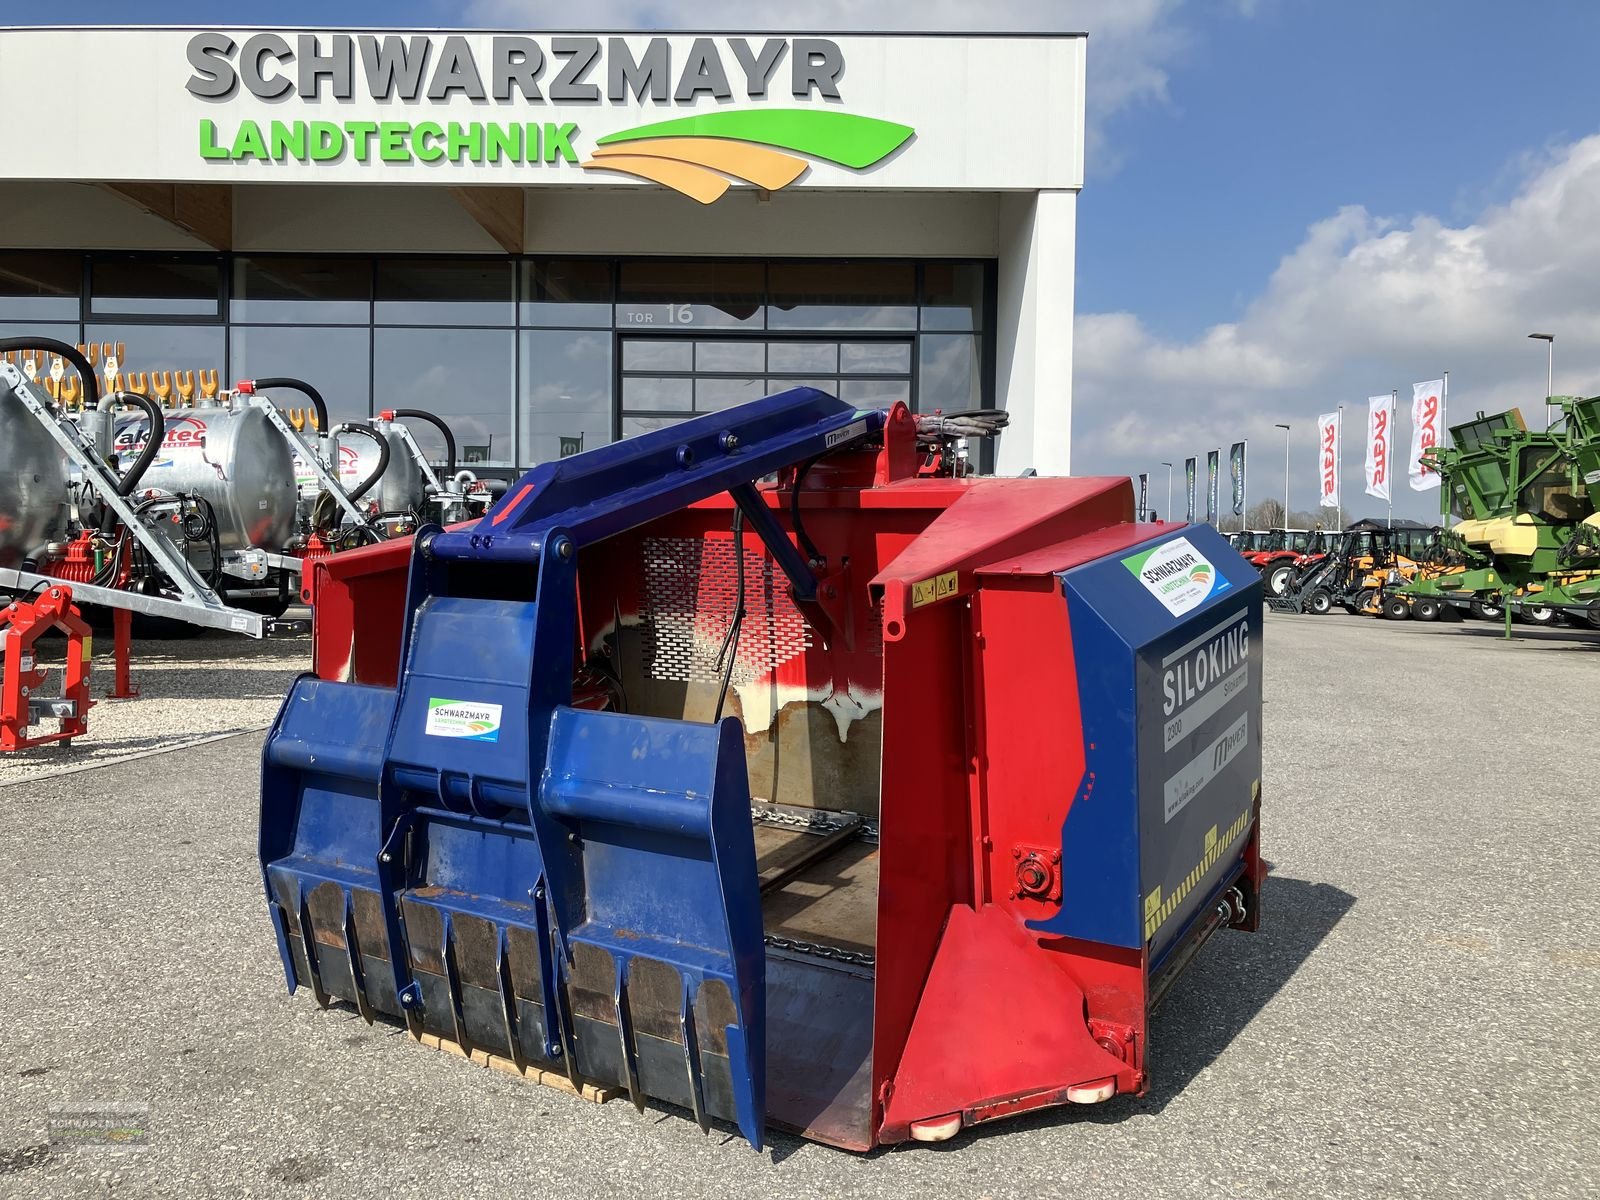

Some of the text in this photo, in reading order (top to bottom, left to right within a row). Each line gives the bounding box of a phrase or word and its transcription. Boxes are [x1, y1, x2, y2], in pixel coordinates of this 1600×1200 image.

[185, 32, 844, 103] SCHWARZMAYR
[199, 119, 580, 164] LANDTECHNIK
[627, 303, 694, 324] TOR 16
[1142, 553, 1198, 584] SCHWARZMAYR
[1163, 620, 1249, 717] SILOKING
[435, 708, 491, 720] SCHWARZMAYR
[1167, 719, 1182, 742] 2300
[1213, 723, 1247, 772] MAYER
